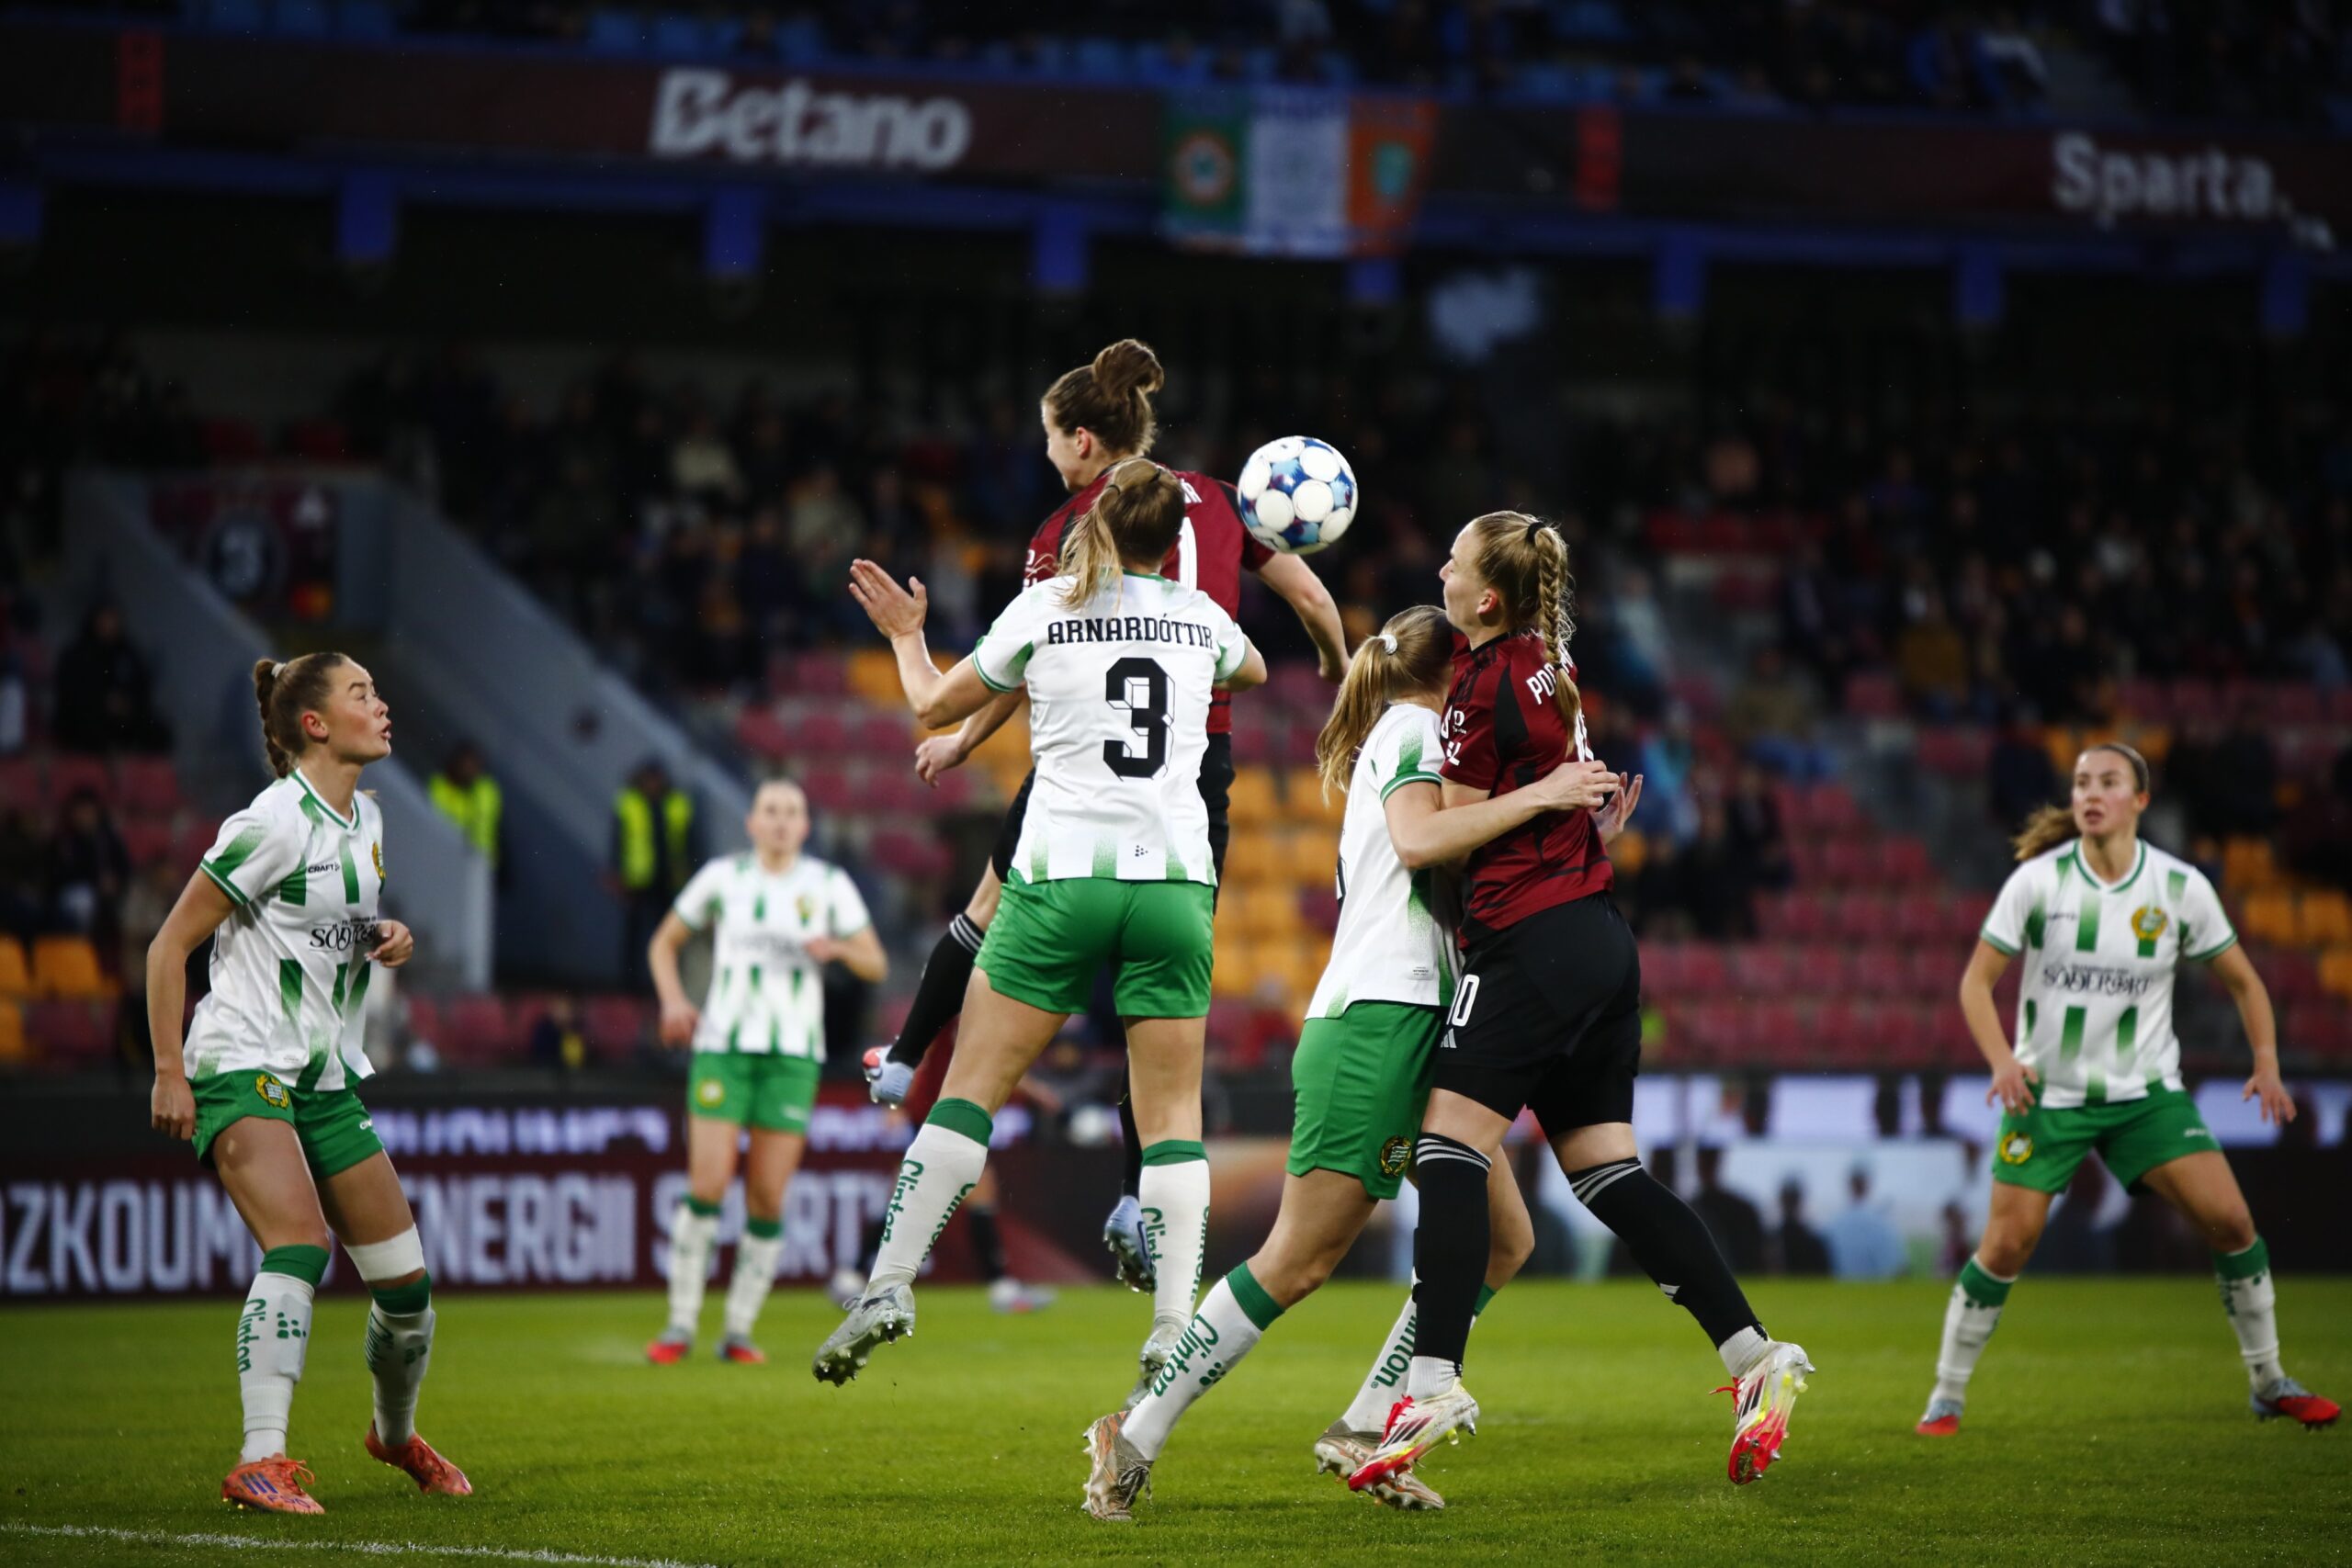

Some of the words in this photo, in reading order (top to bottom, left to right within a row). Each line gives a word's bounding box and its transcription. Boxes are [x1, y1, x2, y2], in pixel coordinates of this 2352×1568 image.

[649, 68, 972, 169] Betano
[2051, 135, 2275, 230] Sparta
[1047, 614, 1213, 649] ARNARDÓTTIR
[1102, 657, 1175, 782] 3
[308, 863, 334, 874] CRAFT
[0, 1180, 336, 1292] ZKOUM
[1152, 1313, 1220, 1397] Clinton
